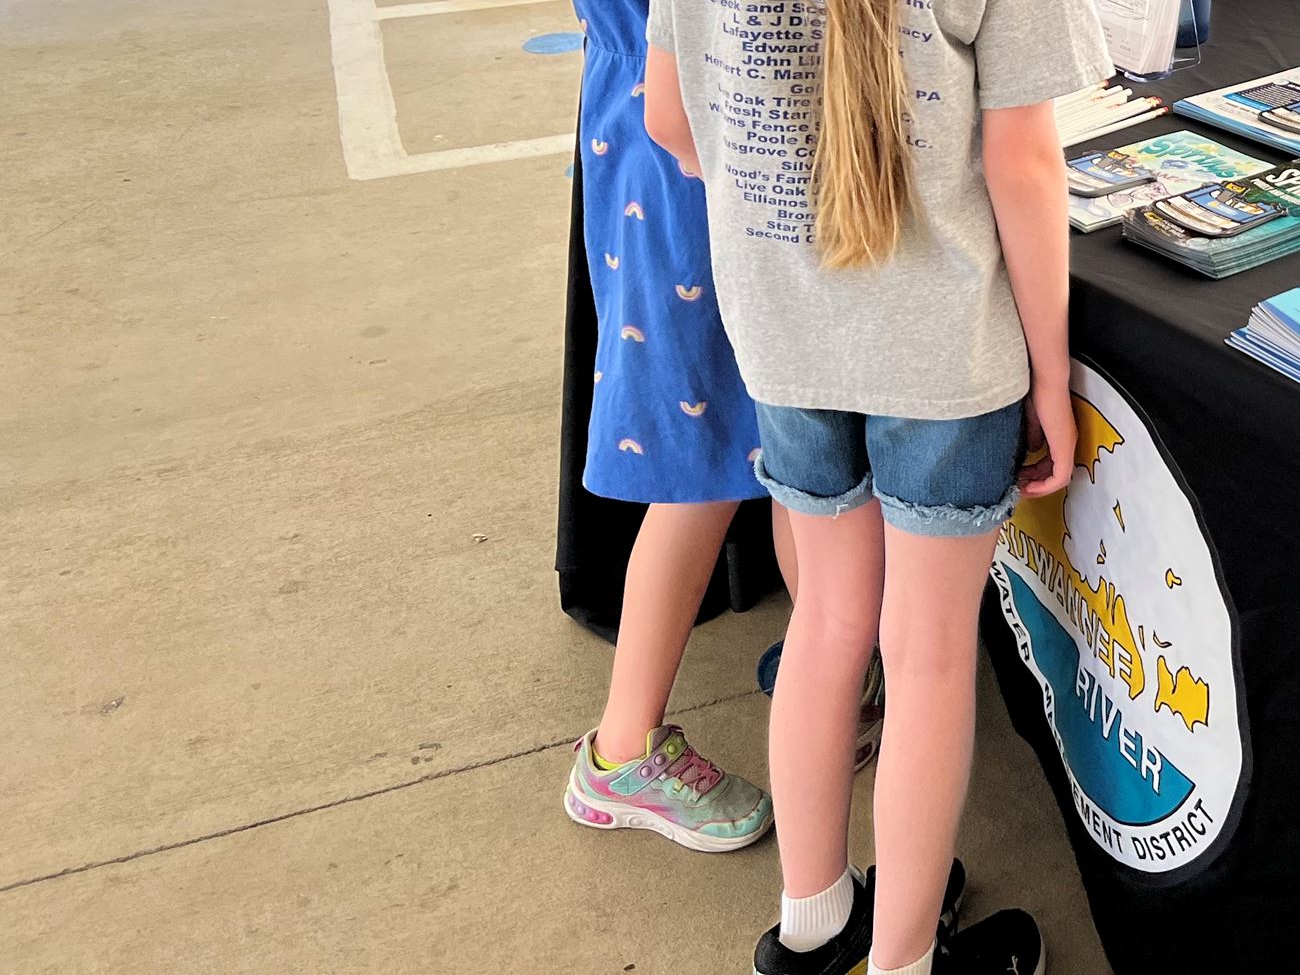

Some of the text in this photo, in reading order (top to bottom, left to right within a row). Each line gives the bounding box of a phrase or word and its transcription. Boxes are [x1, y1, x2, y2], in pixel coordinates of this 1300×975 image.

[746, 3, 784, 13] and
[733, 13, 740, 24] L
[747, 16, 761, 26] &
[770, 16, 782, 26] J
[723, 23, 803, 42] Lafayette
[742, 55, 791, 67] John
[747, 69, 766, 80] C.
[916, 90, 941, 102] PA
[733, 92, 765, 106] Oak
[773, 96, 806, 107] Tire
[752, 120, 809, 132] Fence
[747, 131, 798, 145] Poole
[735, 179, 767, 193] Live
[772, 185, 806, 196] Oak
[743, 192, 809, 208] Ellianos
[767, 220, 799, 233] Star
[746, 227, 800, 243] Second
[995, 522, 1134, 679] SUWANNEE
[990, 561, 1031, 663] WATER
[1131, 797, 1214, 861] DISTRICT
[1076, 667, 1163, 796] RIVER
